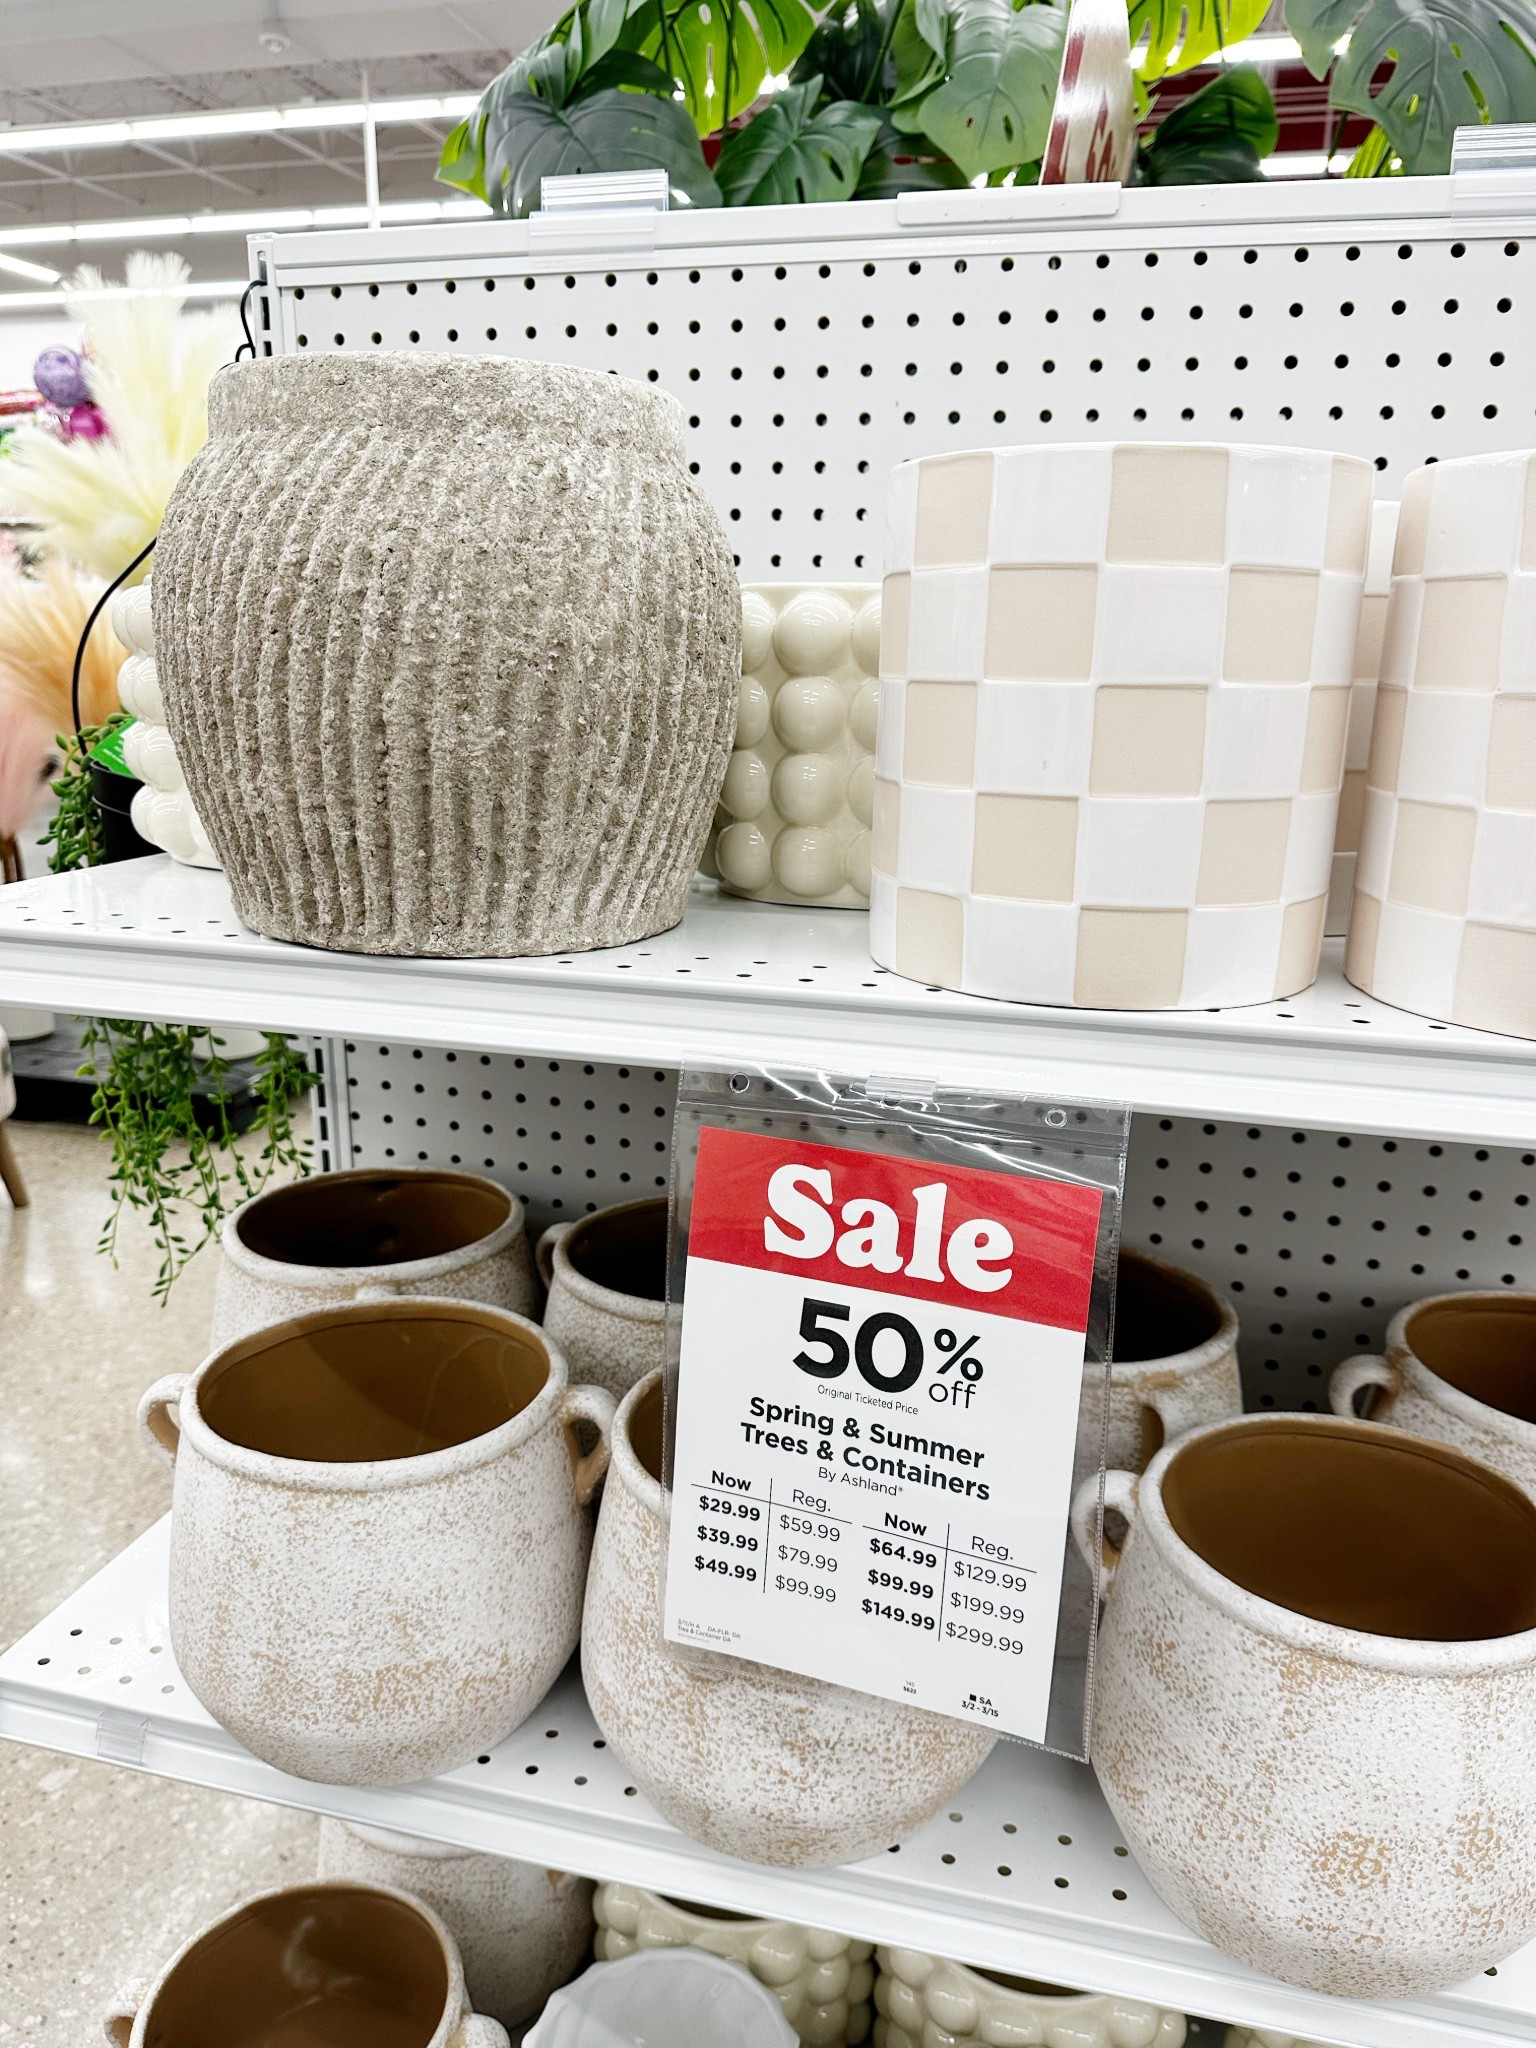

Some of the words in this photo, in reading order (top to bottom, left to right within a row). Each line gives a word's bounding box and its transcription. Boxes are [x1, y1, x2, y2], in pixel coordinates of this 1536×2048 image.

[763, 1163, 1014, 1293] Sale
[817, 1384, 853, 1400] Original
[854, 1392, 893, 1410] Ticketed
[895, 1401, 919, 1416] Price
[928, 1380, 977, 1410] off
[749, 1396, 835, 1436] Spring
[842, 1417, 861, 1439] &
[869, 1423, 985, 1469] Summer
[740, 1421, 808, 1456] Trees
[816, 1439, 834, 1462] &
[842, 1446, 991, 1501] Containers
[818, 1466, 837, 1483] By
[711, 1469, 753, 1492] Now
[792, 1488, 832, 1513] Reg.
[699, 1494, 761, 1522] $29.99
[779, 1514, 841, 1542] $59.99
[884, 1512, 928, 1537] Now
[971, 1535, 1014, 1562] Reg.
[696, 1524, 759, 1552] $39.99
[777, 1544, 839, 1573] $79.99
[869, 1537, 938, 1569] $64.99
[953, 1560, 1028, 1592] $129.99
[694, 1554, 757, 1583] $49.99
[774, 1574, 837, 1604] $99.99
[867, 1568, 934, 1600] $99.99
[950, 1591, 1025, 1624] $199.99
[678, 1625, 689, 1633] Tree
[695, 1630, 722, 1640] Container
[861, 1598, 936, 1632] $149.99
[945, 1621, 1025, 1657] $299.99
[961, 1700, 975, 1711] 3/2
[981, 1706, 999, 1718] 3/15
[979, 1696, 993, 1707] SA
